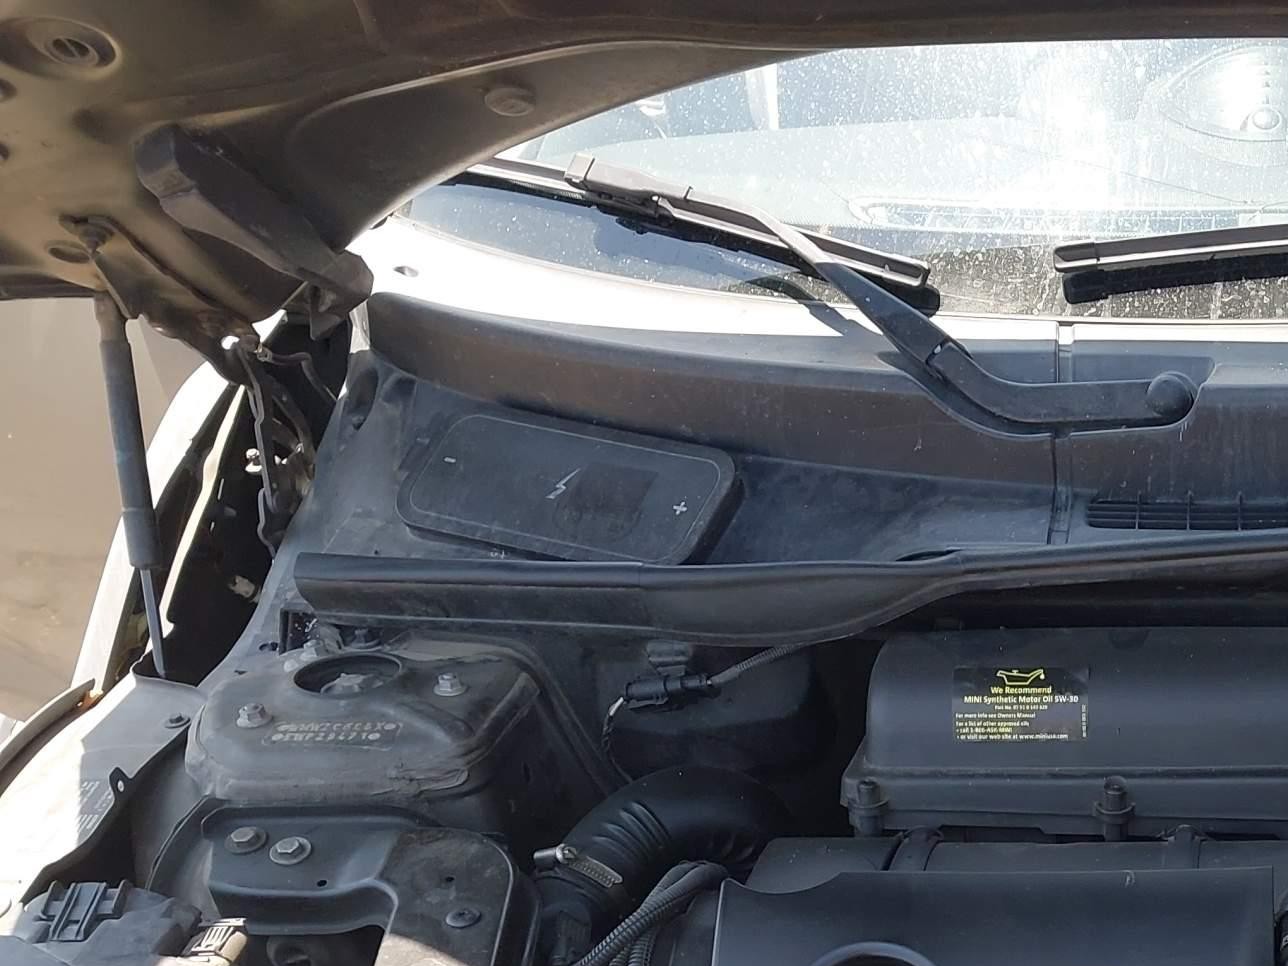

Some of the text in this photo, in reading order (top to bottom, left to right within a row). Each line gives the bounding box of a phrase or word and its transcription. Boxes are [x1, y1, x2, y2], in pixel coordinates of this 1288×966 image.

[990, 685, 1052, 694] We Recommend
[964, 696, 982, 704] MINI
[983, 695, 1017, 705] Synthetic
[1042, 695, 1053, 703] Oil
[1054, 695, 1079, 703] 5W-30
